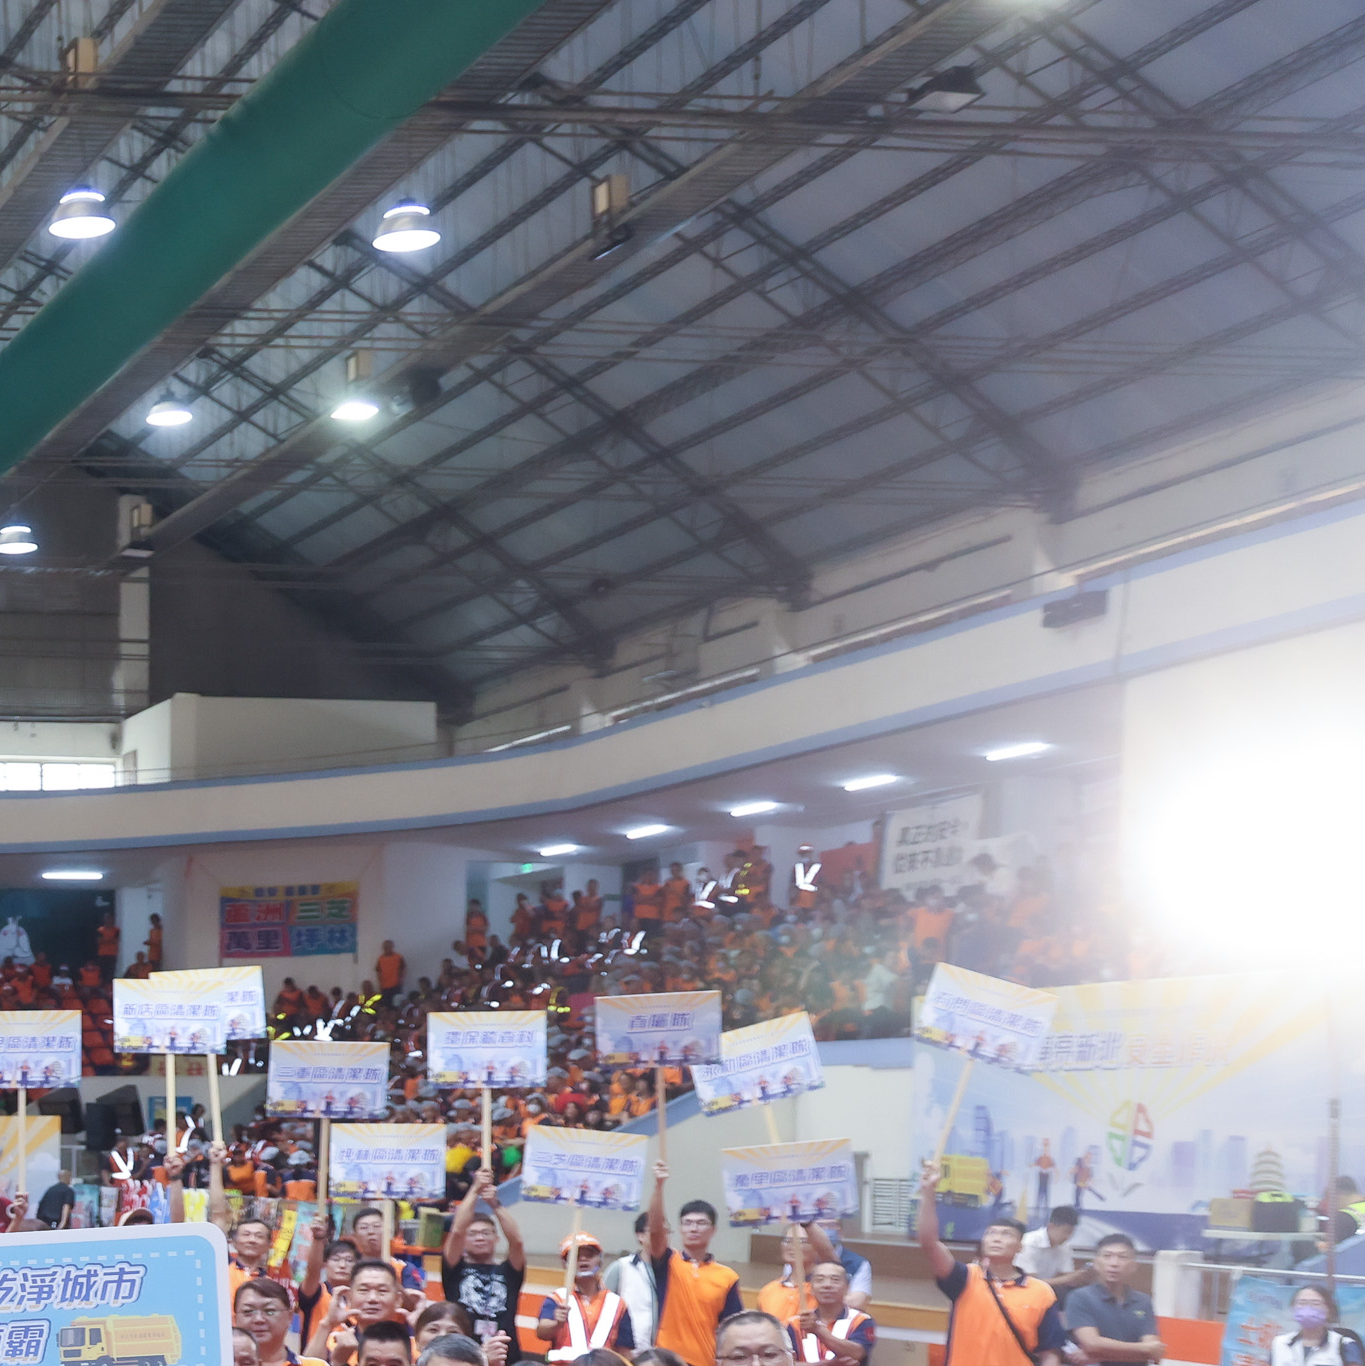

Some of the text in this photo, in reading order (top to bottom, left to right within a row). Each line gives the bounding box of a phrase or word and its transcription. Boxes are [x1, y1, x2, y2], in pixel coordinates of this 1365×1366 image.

[123, 1003, 219, 1018] 新店區清潔隊
[277, 1066, 383, 1082] 三重區清潔隊
[530, 1151, 640, 1176] 三芝區清潔隊
